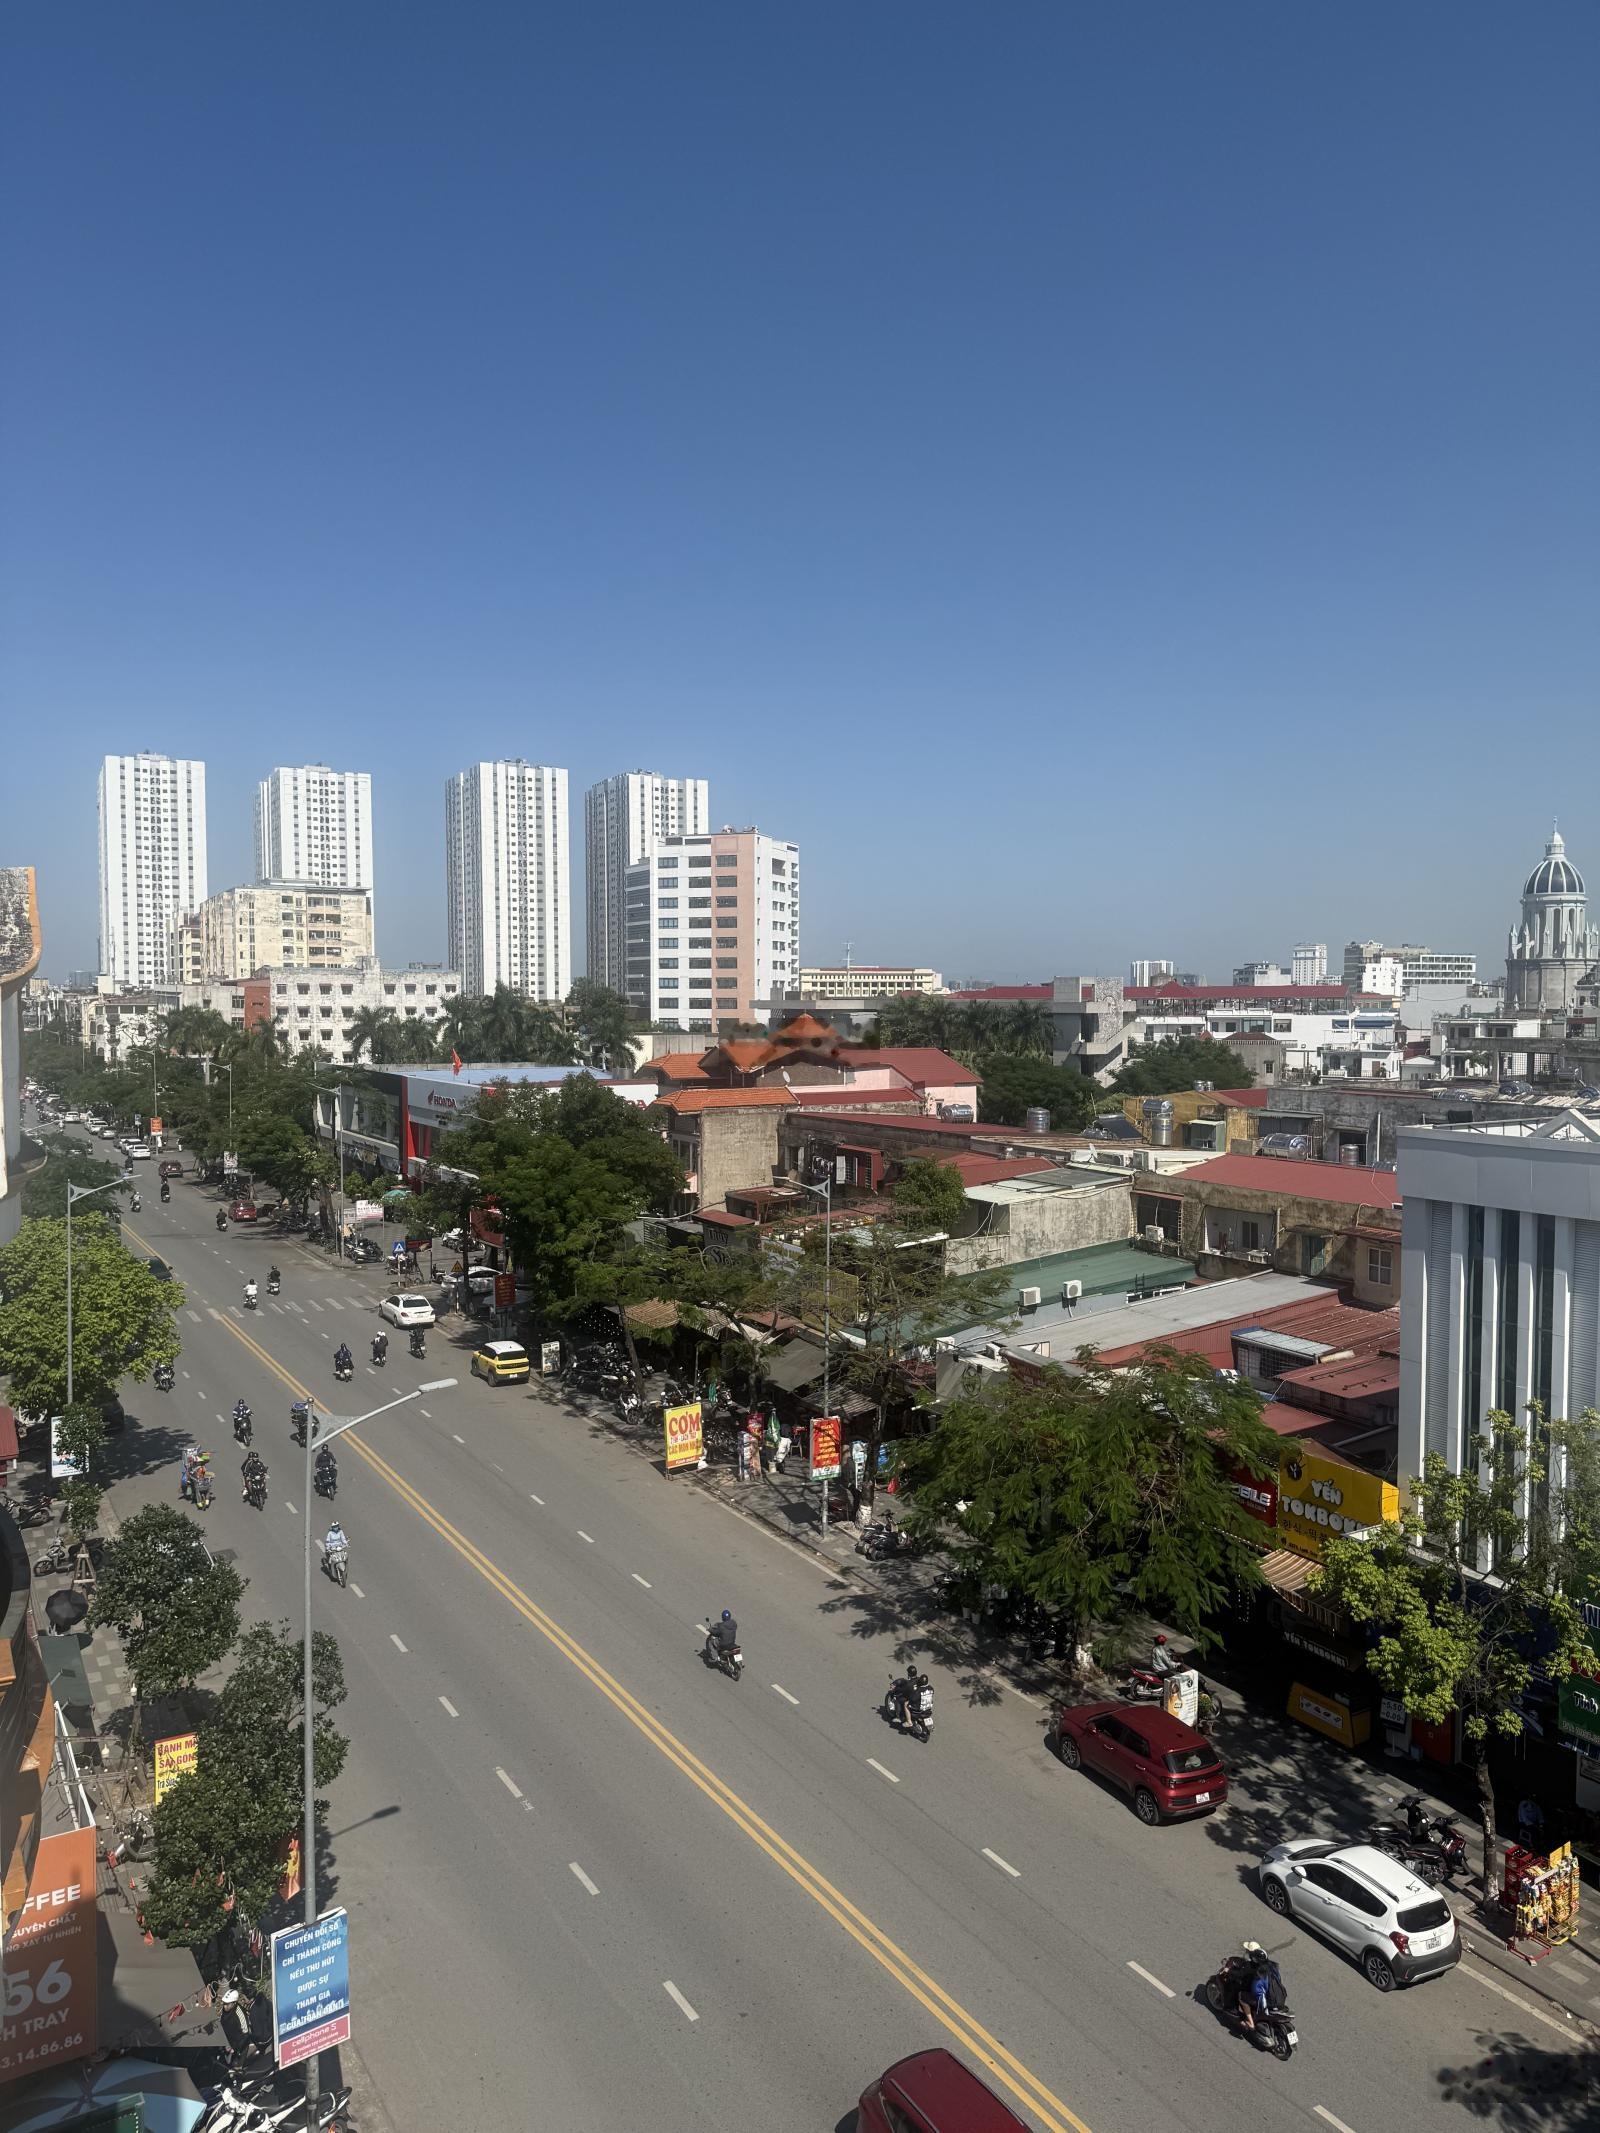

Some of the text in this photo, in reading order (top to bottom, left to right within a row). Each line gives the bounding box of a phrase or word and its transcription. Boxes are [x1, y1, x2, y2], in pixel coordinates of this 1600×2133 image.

[433, 1095, 458, 1108] HONDA
[321, 1938, 342, 1951] CÔNG
[306, 1961, 321, 1974] THU
[296, 1989, 331, 2012] THAM GIA
[23, 2007, 71, 2035] TRAY
